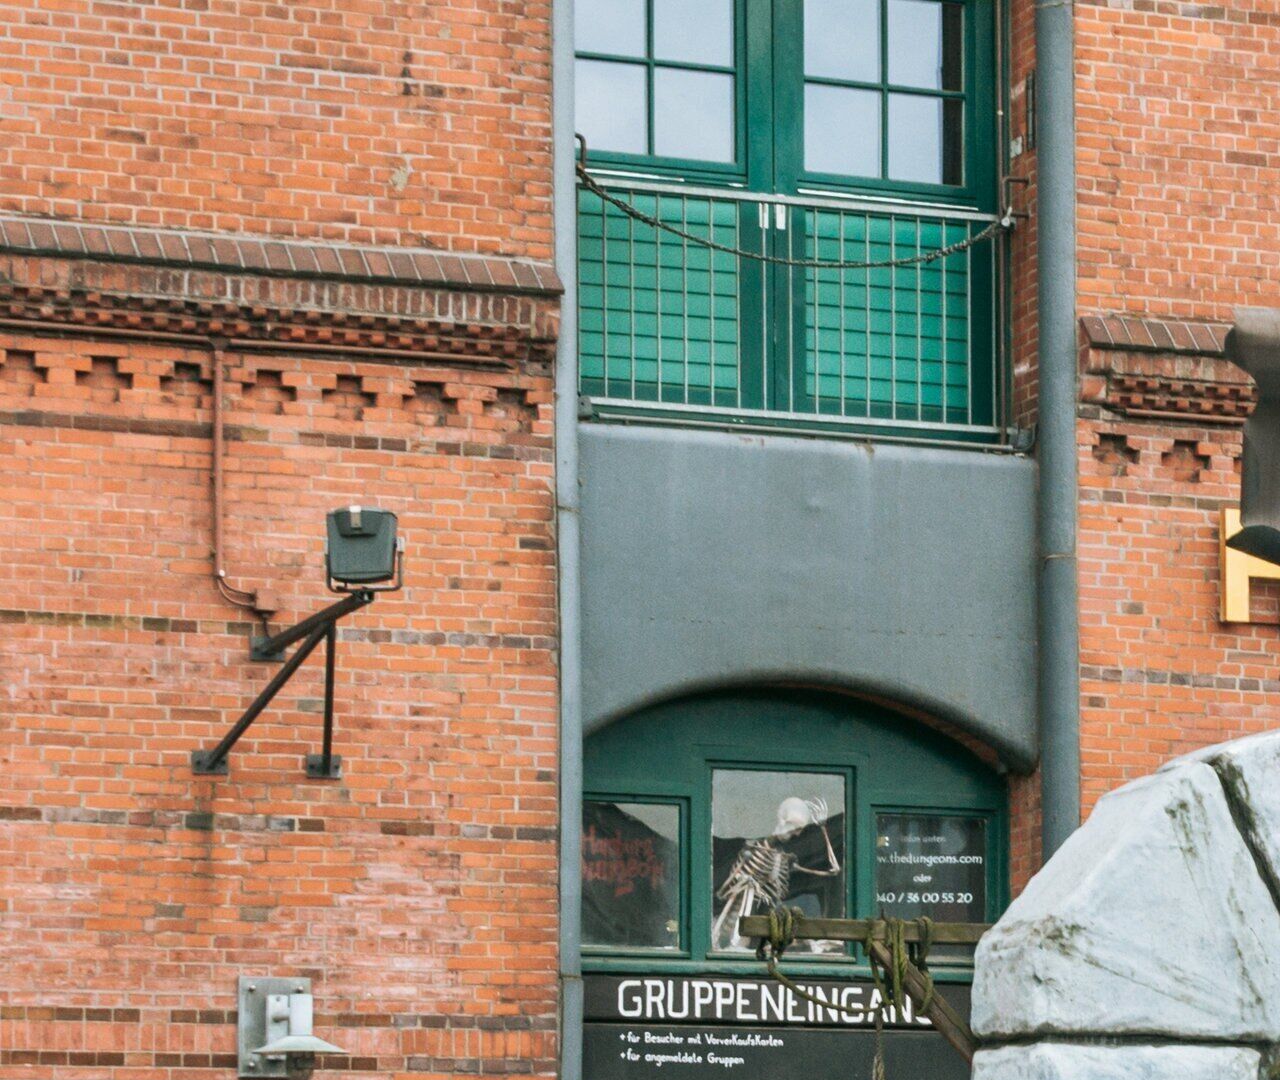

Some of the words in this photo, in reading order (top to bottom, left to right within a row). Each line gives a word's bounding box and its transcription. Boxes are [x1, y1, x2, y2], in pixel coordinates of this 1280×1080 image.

[922, 892, 940, 904] 00
[941, 892, 955, 904] 55
[956, 892, 974, 904] 20
[617, 979, 933, 1025] GRUPPENEINGAN
[644, 1032, 685, 1045] Besucher
[687, 1033, 702, 1045] mit
[645, 1051, 703, 1067] angemeldete
[707, 1052, 745, 1068] Gruppen
